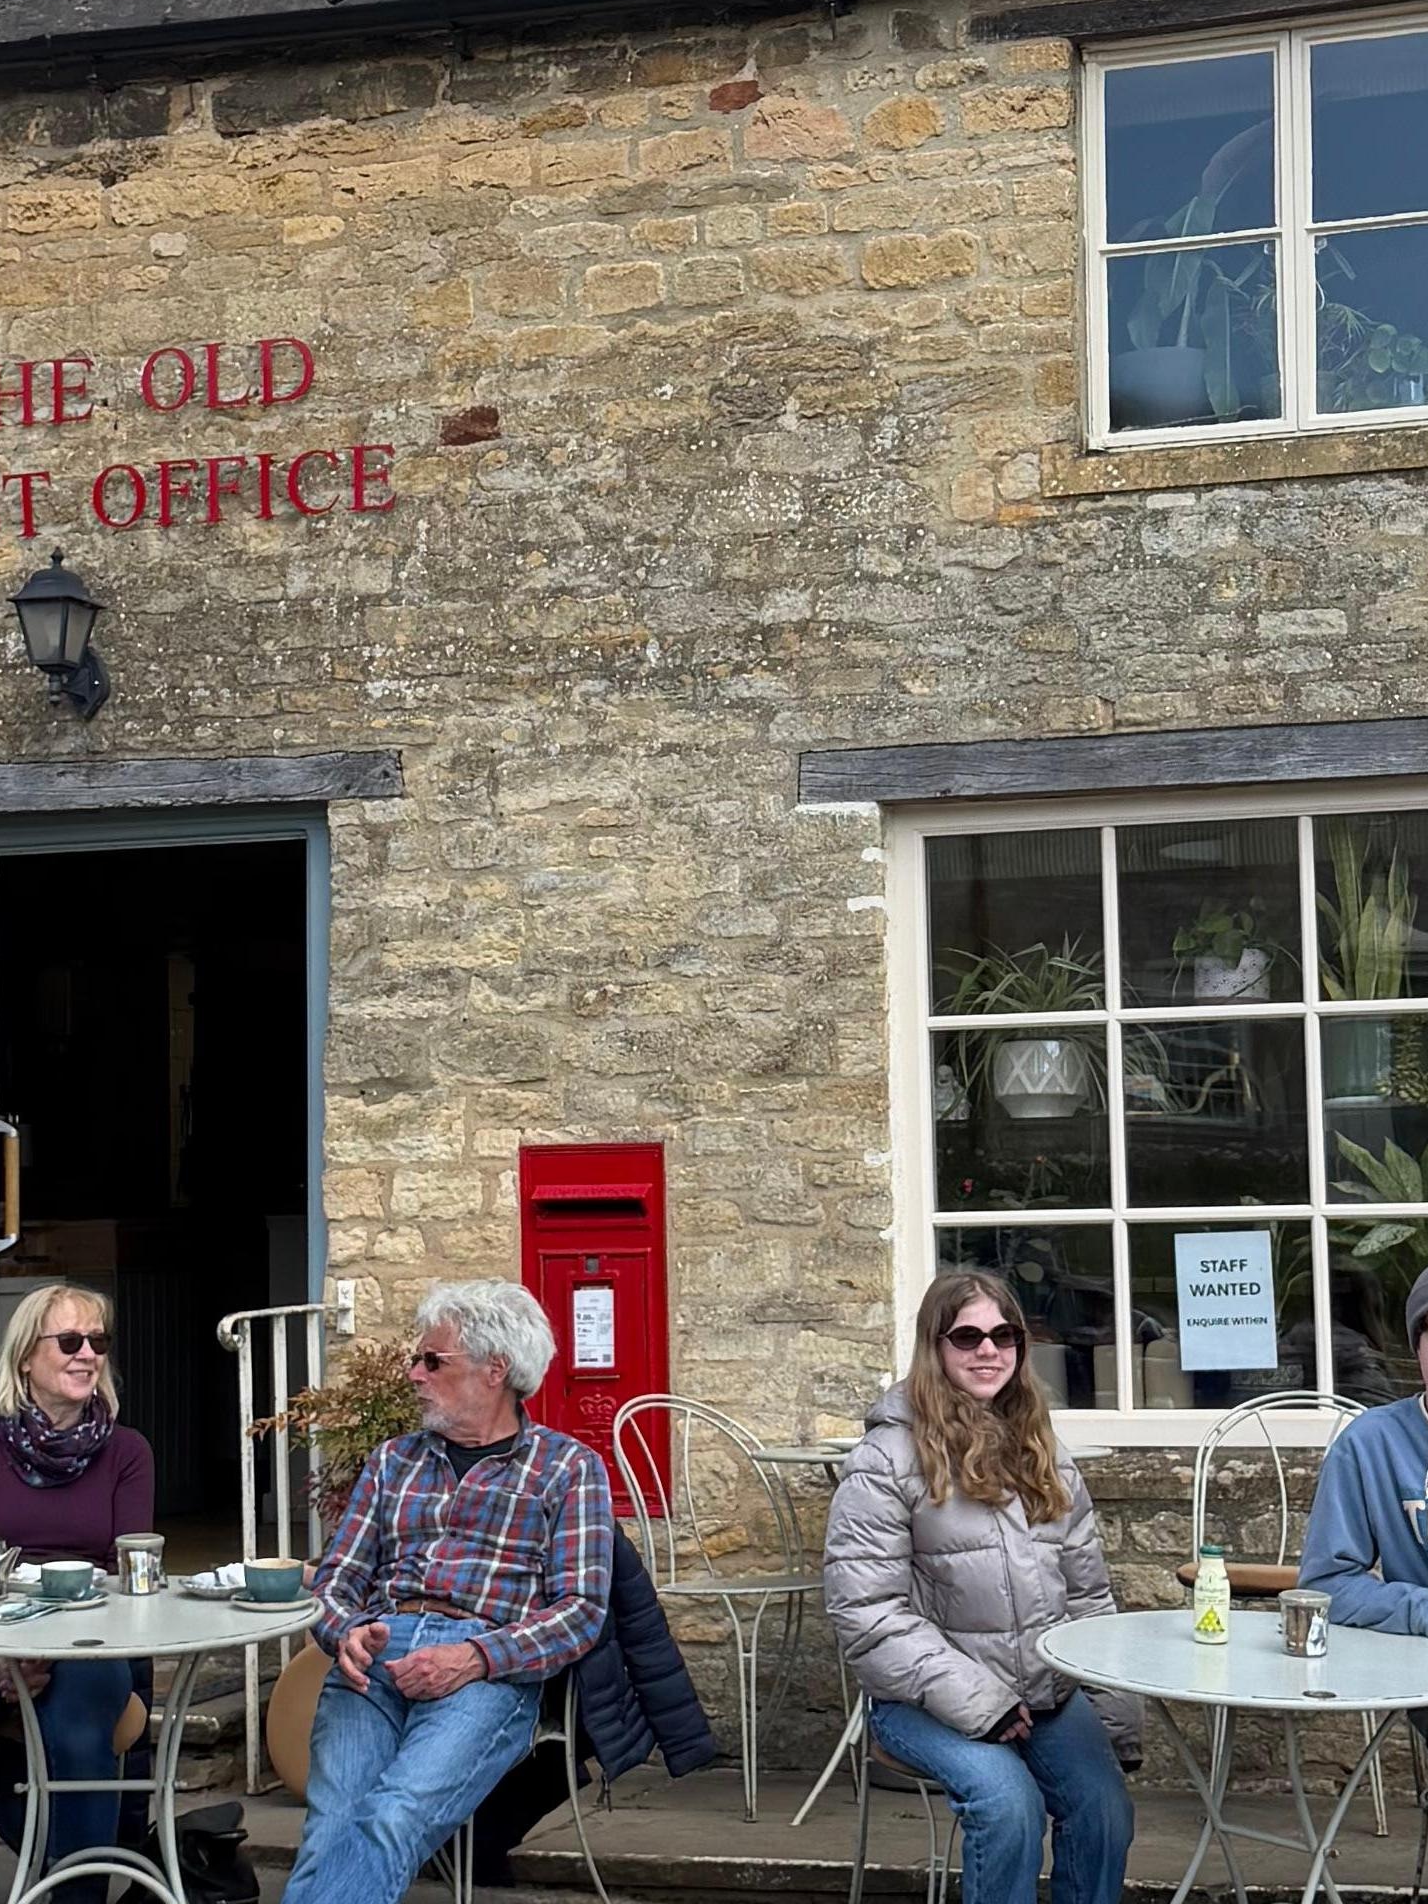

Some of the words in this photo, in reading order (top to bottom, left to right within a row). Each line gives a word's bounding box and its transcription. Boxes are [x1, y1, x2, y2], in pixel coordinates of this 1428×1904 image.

[140, 337, 316, 412] OLD
[91, 443, 397, 530] OFFICE
[1199, 1258, 1249, 1274] STAFF
[1189, 1282, 1261, 1297] WANTED
[1185, 1317, 1230, 1328] ENQUIRE
[1230, 1316, 1268, 1326] WITHIN
